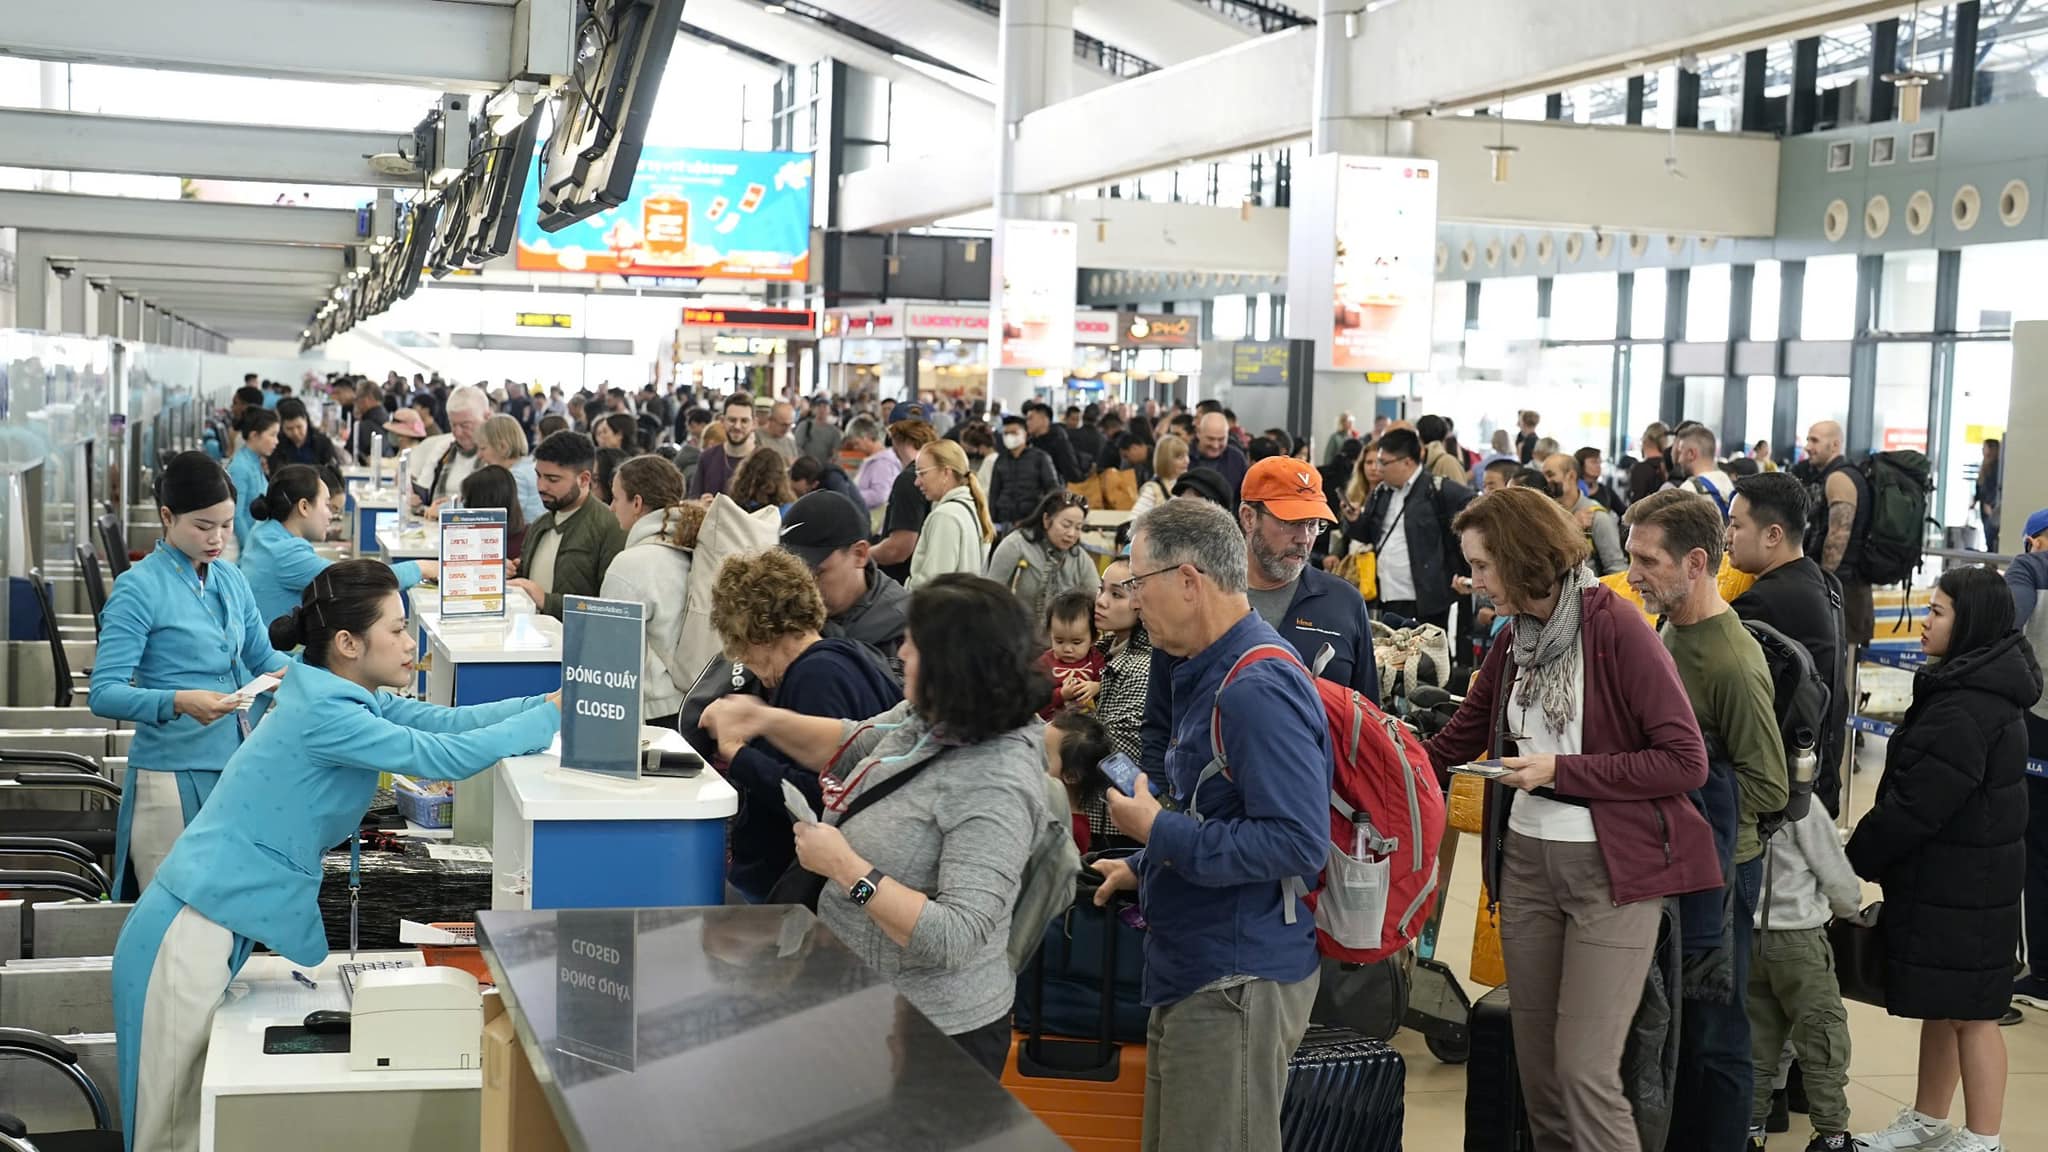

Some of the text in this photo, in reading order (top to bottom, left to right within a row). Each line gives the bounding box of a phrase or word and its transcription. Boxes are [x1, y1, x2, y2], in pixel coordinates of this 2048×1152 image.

[1297, 472, 1310, 485] V
[566, 665, 602, 685] ĐÓNG
[576, 699, 625, 721] CLOSED
